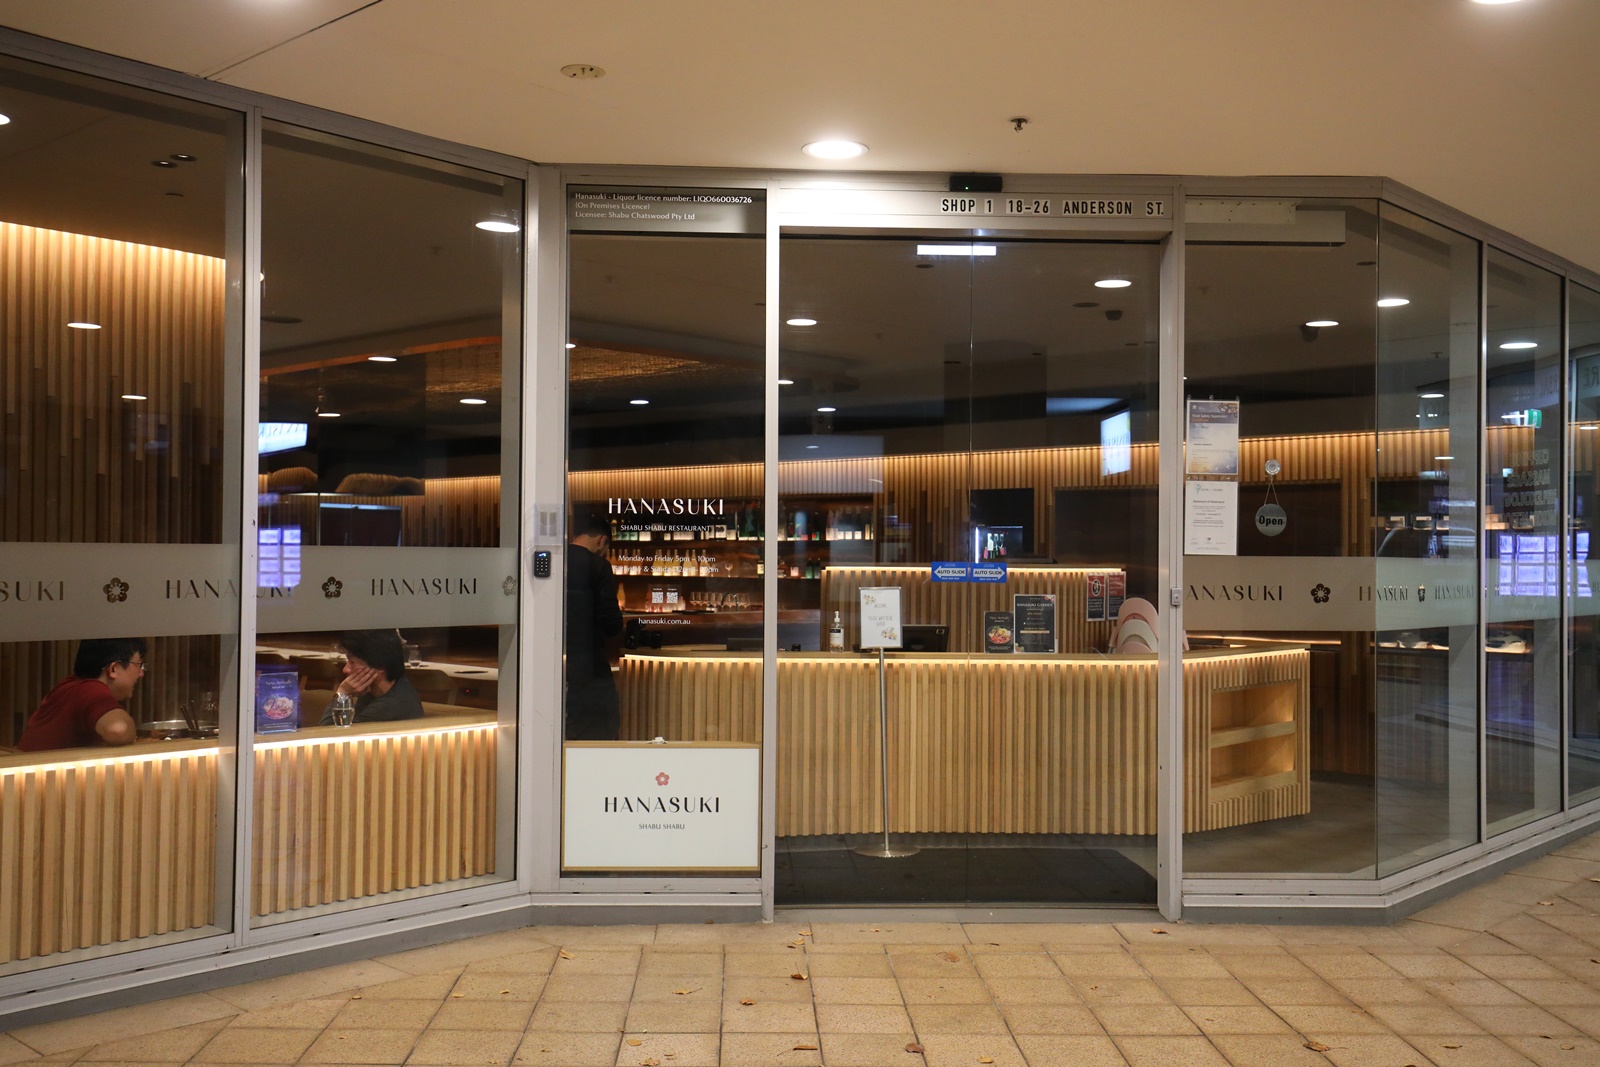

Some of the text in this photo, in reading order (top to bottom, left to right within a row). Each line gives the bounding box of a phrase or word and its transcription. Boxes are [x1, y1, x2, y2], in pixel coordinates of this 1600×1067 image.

[613, 194, 635, 202] Liquor
[942, 199, 1164, 215] SHOP 1 18-26 ANDERSON ST.
[631, 212, 670, 220] Chatswood
[671, 213, 683, 221] Pty
[608, 497, 724, 515] HANASUKI
[1259, 515, 1283, 527] Open
[618, 555, 645, 563] Monday
[654, 555, 674, 563] Friday
[697, 555, 716, 563] 10pm
[643, 565, 650, 573] &
[371, 578, 477, 596] HANASUKI
[1435, 584, 1474, 600] HANASUKI
[604, 796, 720, 813] HANASUKI
